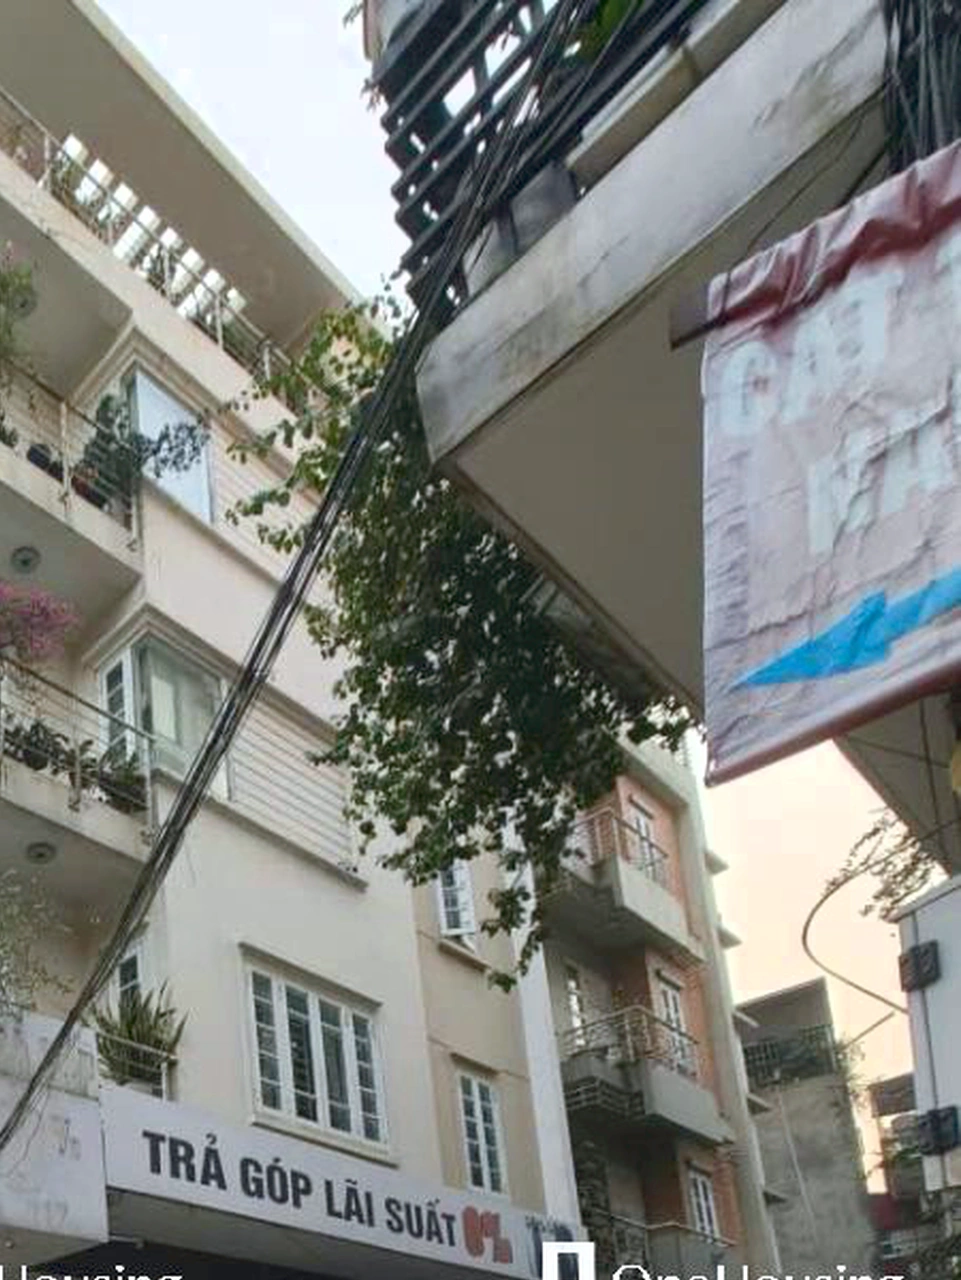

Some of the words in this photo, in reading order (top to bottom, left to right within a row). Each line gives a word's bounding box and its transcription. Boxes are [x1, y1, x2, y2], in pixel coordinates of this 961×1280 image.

[142, 1130, 228, 1191] TRẢ
[240, 1156, 313, 1210] GÓP
[324, 1177, 376, 1228] LÃI
[385, 1197, 456, 1247] SUẤT
